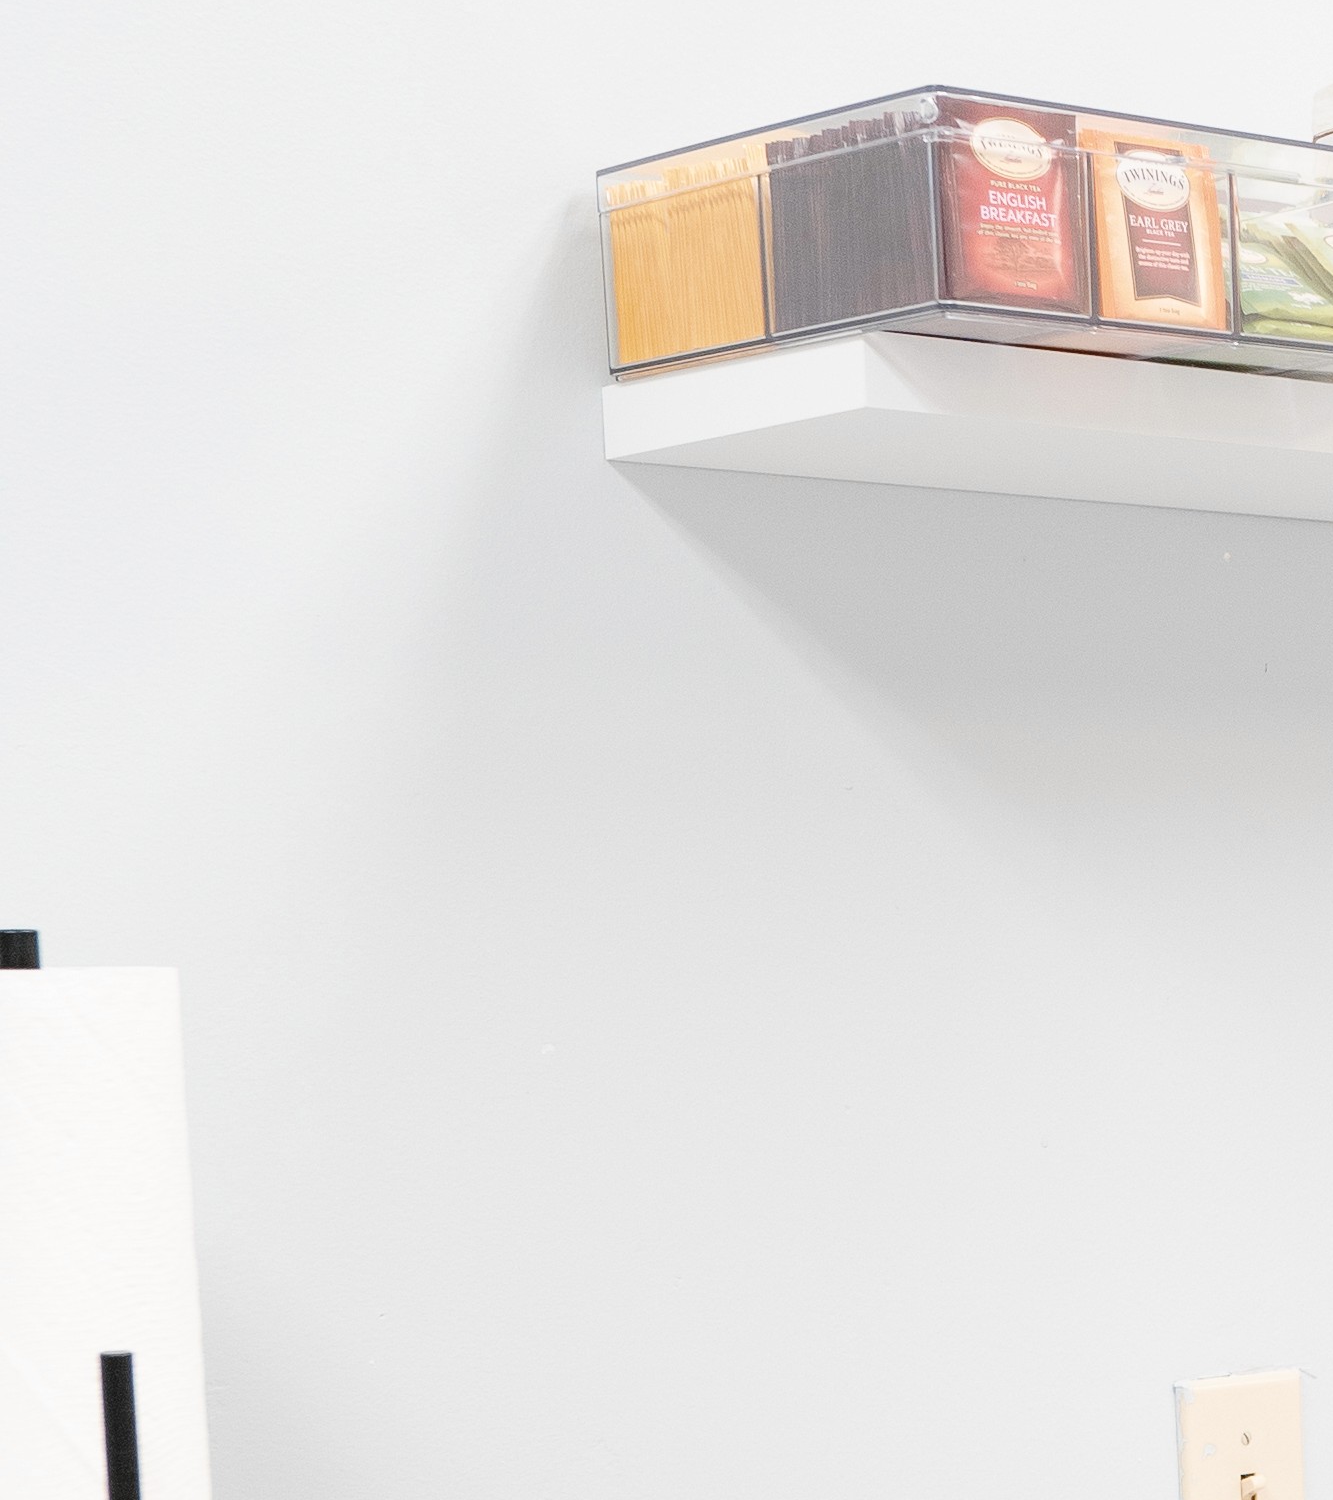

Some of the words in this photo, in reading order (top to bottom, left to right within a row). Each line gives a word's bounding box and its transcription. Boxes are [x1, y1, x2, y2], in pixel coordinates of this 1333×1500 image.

[1123, 168, 1184, 190] TWININGS
[988, 189, 1047, 211] ENGLISH
[980, 205, 1058, 228] BREAKFAST
[1128, 214, 1159, 229] EARL
[1160, 218, 1189, 233] GREY
